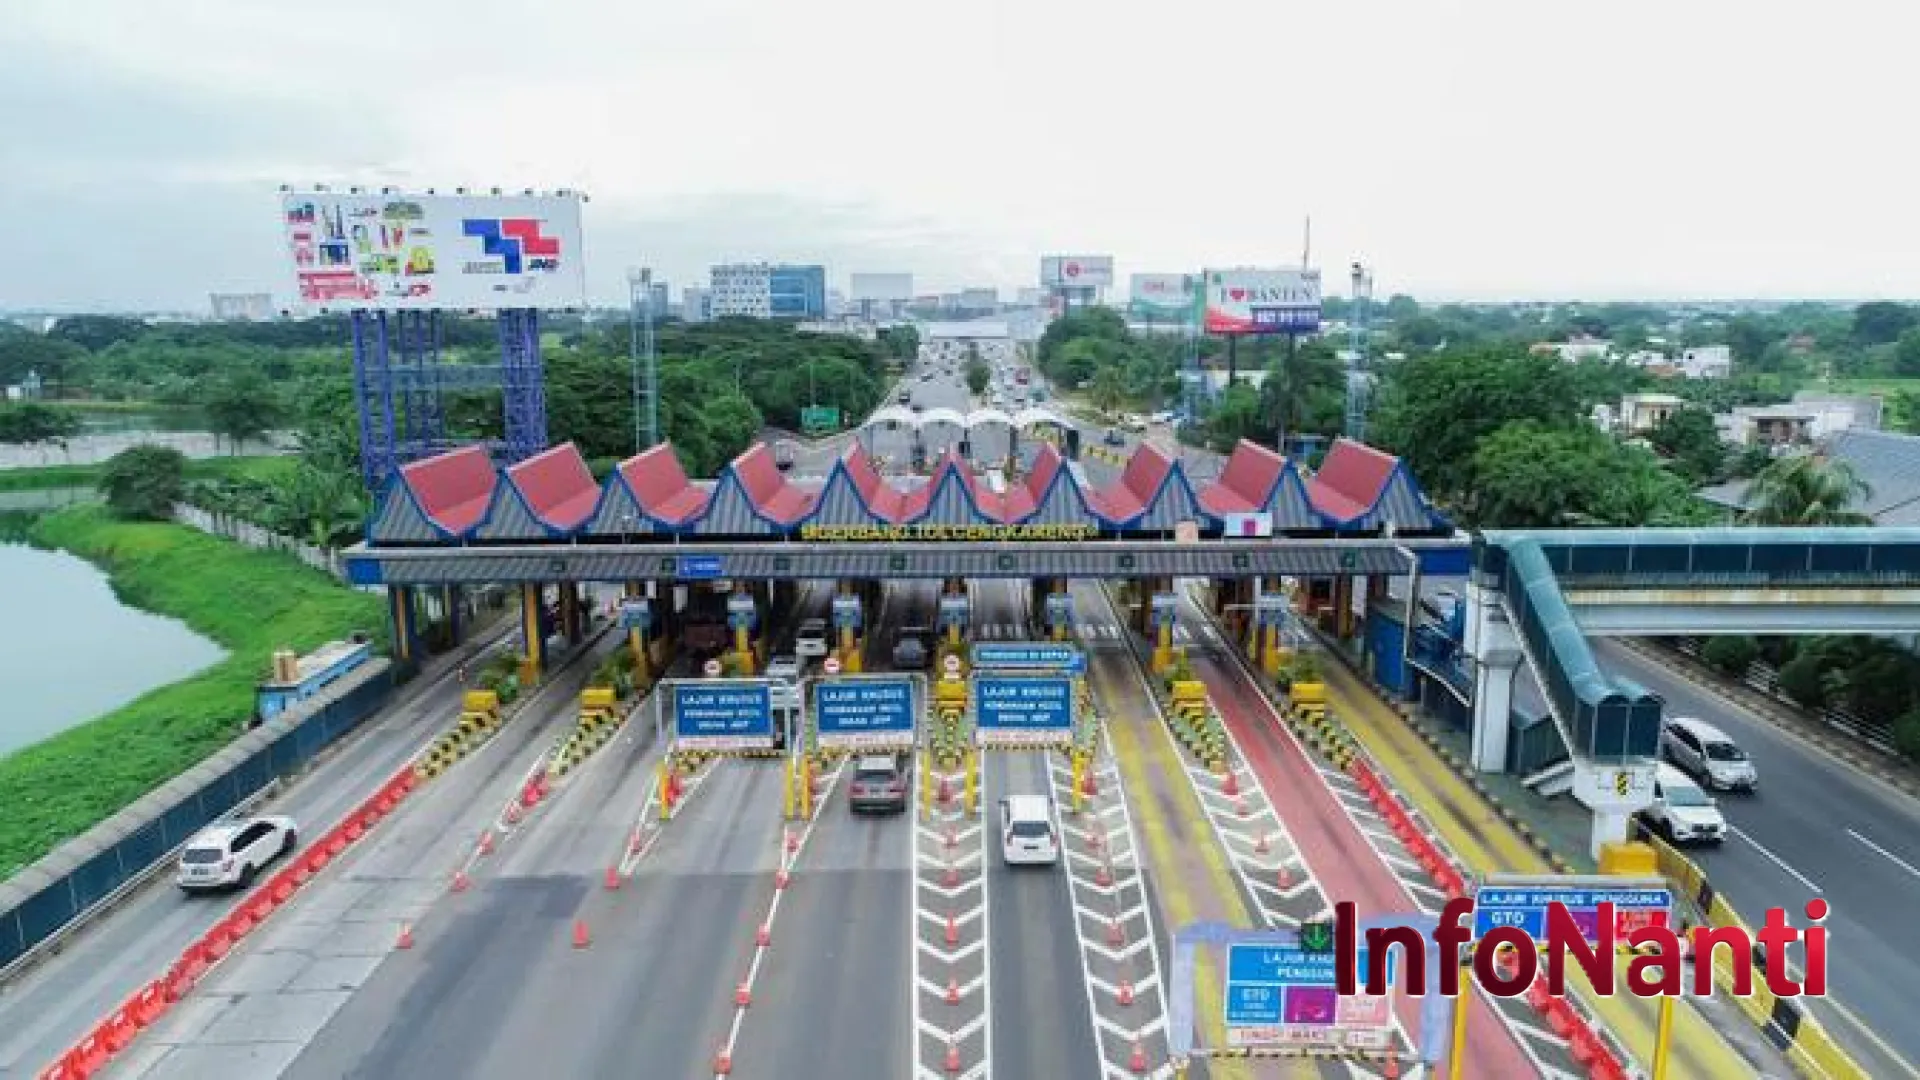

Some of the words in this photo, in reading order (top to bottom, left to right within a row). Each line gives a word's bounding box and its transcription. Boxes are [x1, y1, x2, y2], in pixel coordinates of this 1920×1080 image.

[822, 690, 857, 701] LAJUR
[983, 686, 1016, 696] LAJUR
[681, 694, 714, 704] LAJUR
[1482, 893, 1527, 904] LAJUR
[1531, 893, 1584, 904] KHUSUS
[1592, 893, 1662, 904] PENGGUNA
[1491, 912, 1525, 925] GTO
[1263, 951, 1304, 964] LAJUR
[1277, 967, 1336, 979] PENGGUN
